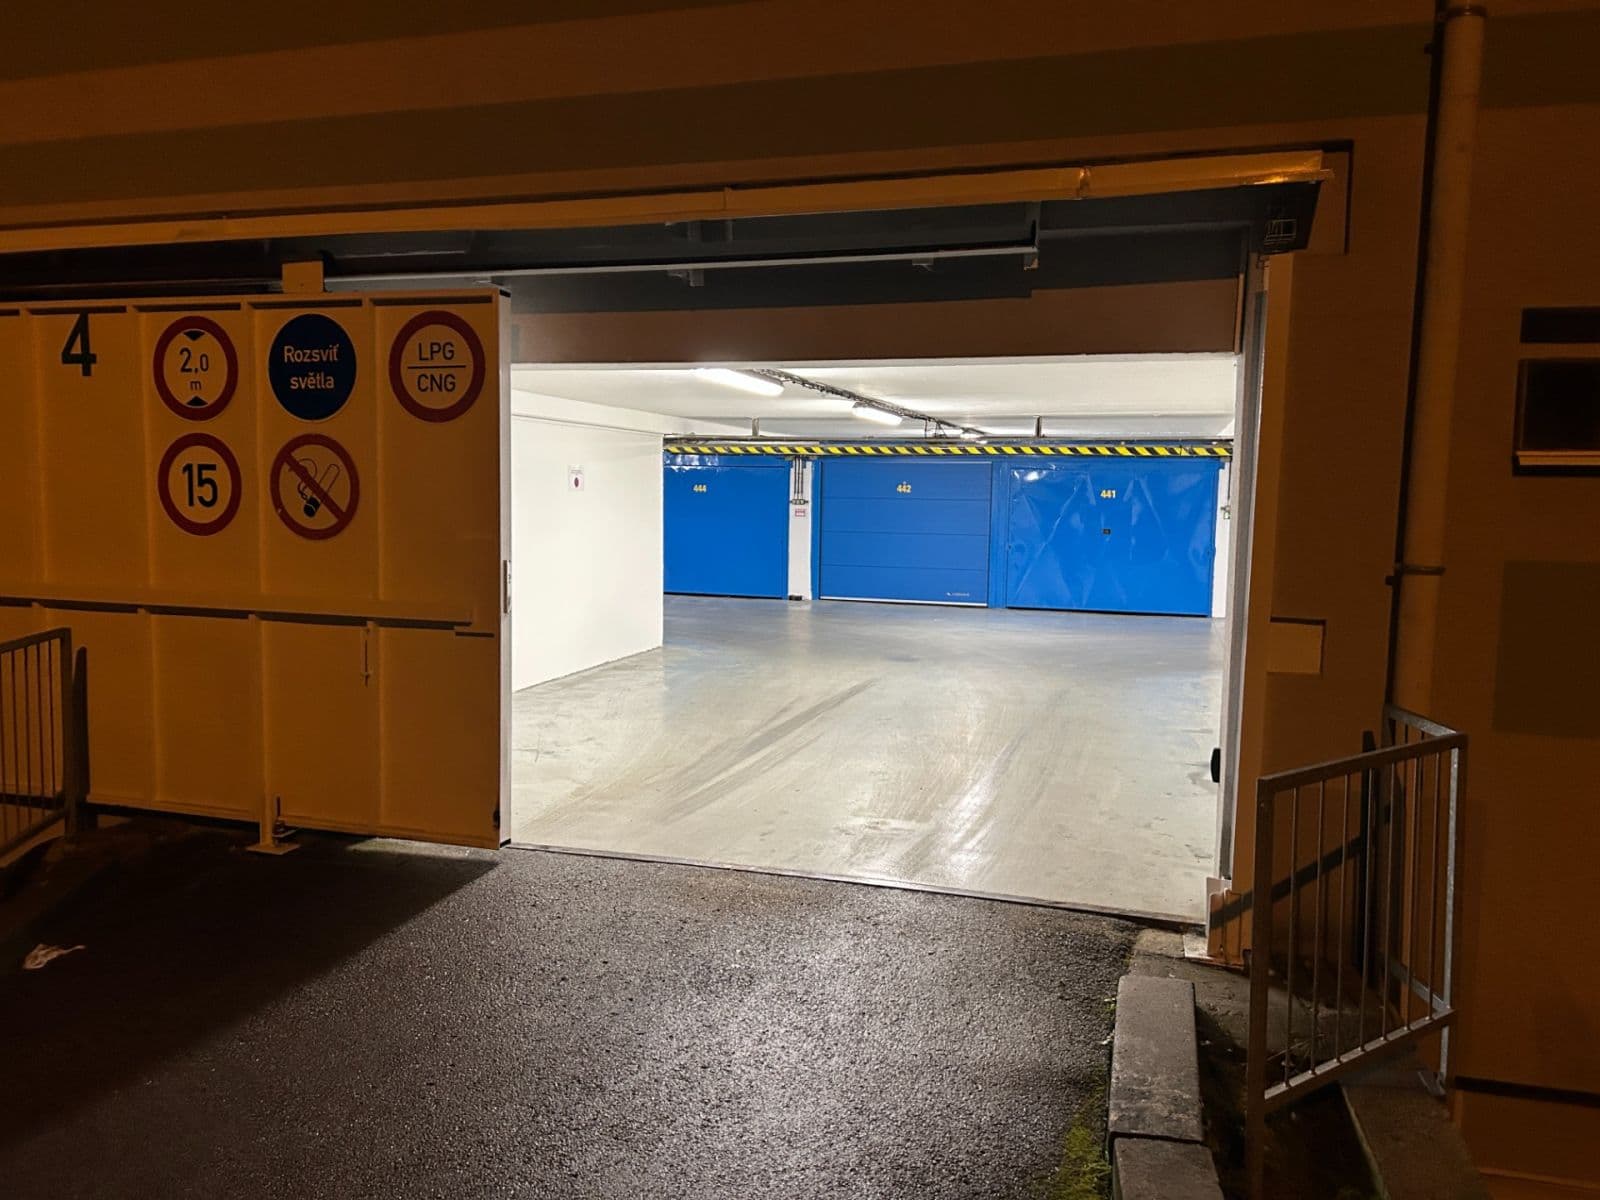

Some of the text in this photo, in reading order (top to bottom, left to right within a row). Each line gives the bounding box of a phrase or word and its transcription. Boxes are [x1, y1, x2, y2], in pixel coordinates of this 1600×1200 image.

[61, 313, 97, 377] 4
[283, 343, 339, 363] Rozsviť
[418, 342, 455, 361] LPG
[190, 379, 202, 391] m
[289, 372, 335, 391] světla
[417, 374, 456, 393] CNG
[181, 462, 219, 508] 15
[1100, 490, 1117, 499] 441
